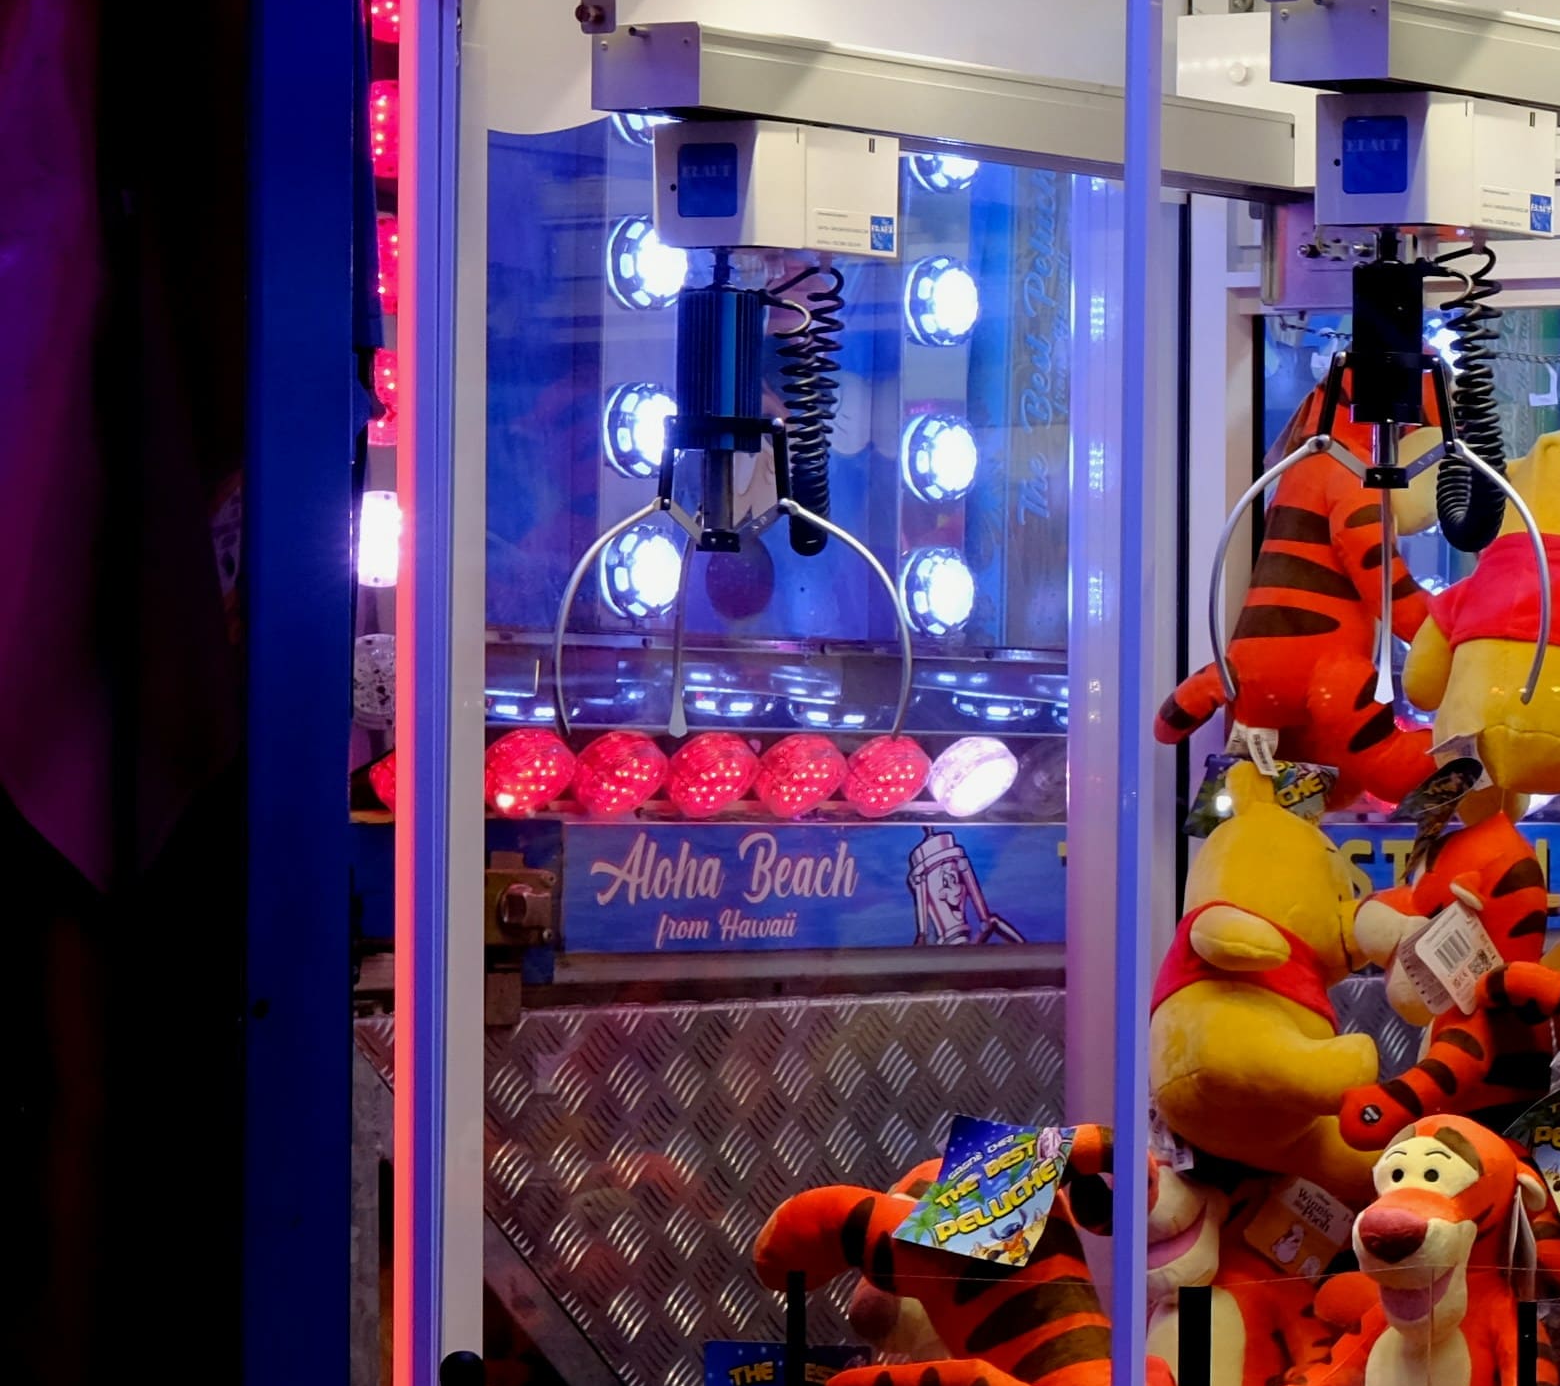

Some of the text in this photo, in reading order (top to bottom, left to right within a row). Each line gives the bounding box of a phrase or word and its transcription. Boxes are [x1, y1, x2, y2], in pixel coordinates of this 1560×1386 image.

[591, 832, 859, 905] Aloha Beach
[656, 909, 797, 950] from Hawaii
[934, 1157, 1058, 1243] PELUCHE
[935, 1140, 1037, 1209] THE BEST
[729, 1362, 774, 1386] THE
